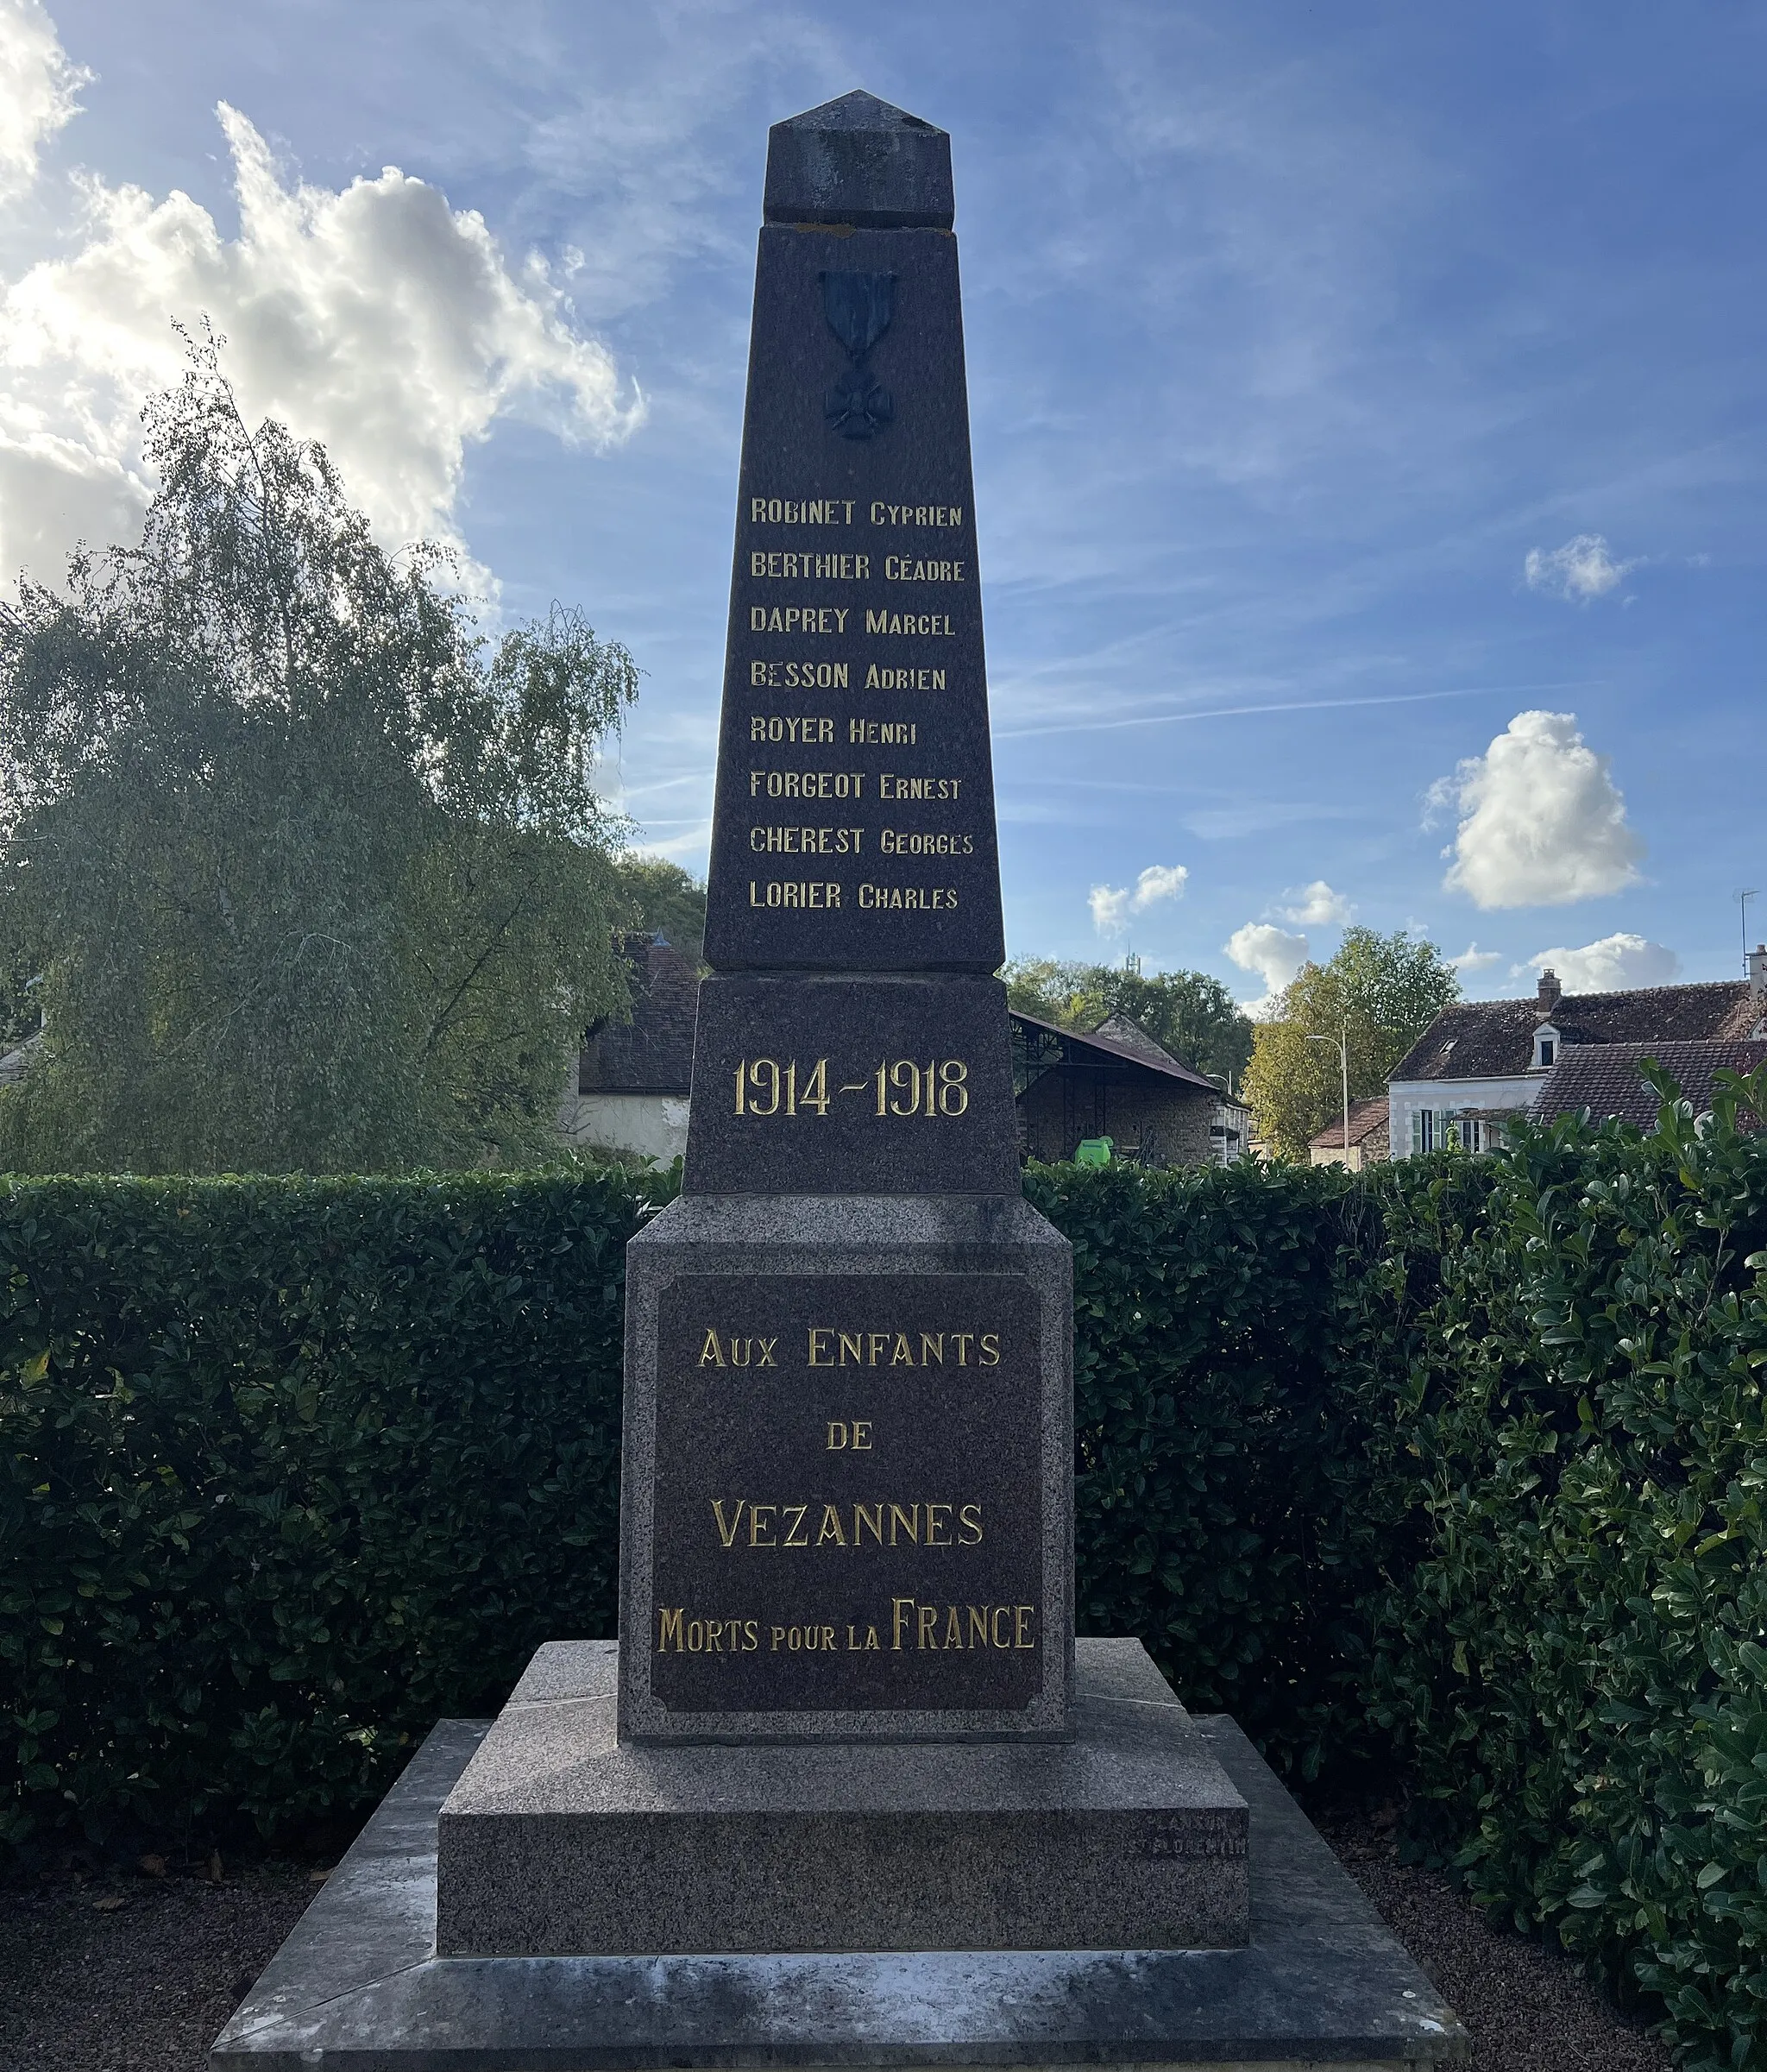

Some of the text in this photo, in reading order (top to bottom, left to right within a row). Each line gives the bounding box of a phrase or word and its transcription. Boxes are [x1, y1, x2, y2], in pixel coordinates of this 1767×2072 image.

[751, 497, 962, 526] ROBINET CYPRIEN
[751, 551, 965, 582] BERTHIER CÉADRE
[751, 607, 956, 636] DAPREY MARCEL
[751, 660, 946, 690] BESSON ADRIEN
[751, 716, 916, 745] ROYER HENRI
[751, 771, 962, 800] FORGEOT ERNEST
[750, 827, 974, 854] CHEREST GEORGES
[750, 880, 959, 910] LORIER CHARLES
[696, 1328, 1002, 1367] AUX ENFANTS
[825, 1420, 874, 1450] DE
[710, 1498, 984, 1547] VEZANNES
[657, 1597, 1036, 1653] MORTS POUR LA FRANCE
